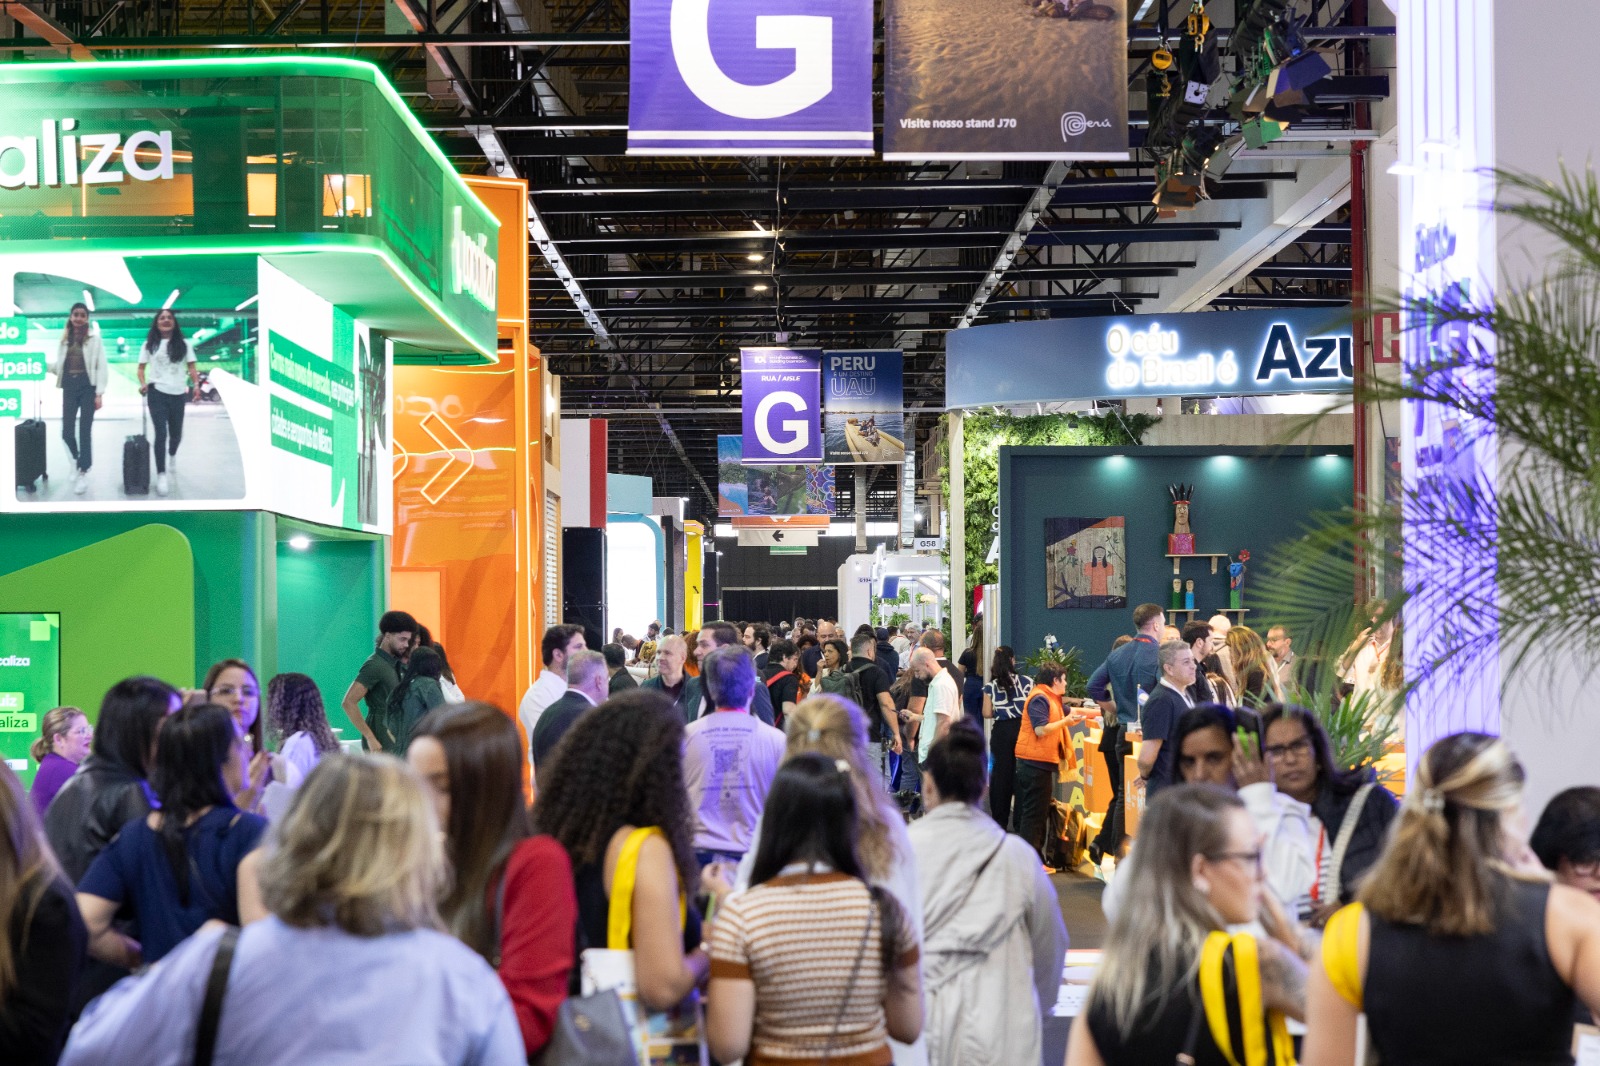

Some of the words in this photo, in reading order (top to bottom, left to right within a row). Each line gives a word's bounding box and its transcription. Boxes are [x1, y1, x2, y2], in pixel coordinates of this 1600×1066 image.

[670, 0, 833, 119] G
[899, 118, 931, 128] Visite
[932, 120, 963, 128] nosso
[965, 118, 995, 128] stand
[997, 118, 1017, 128] J70
[1106, 327, 1124, 354] O
[1130, 323, 1177, 353] céu
[831, 356, 876, 371] PERU
[1106, 357, 1140, 386] do
[1142, 354, 1215, 385] Brasil
[1217, 351, 1237, 383] é
[831, 377, 876, 396] UAU
[754, 390, 809, 455] G
[920, 540, 936, 548] G58
